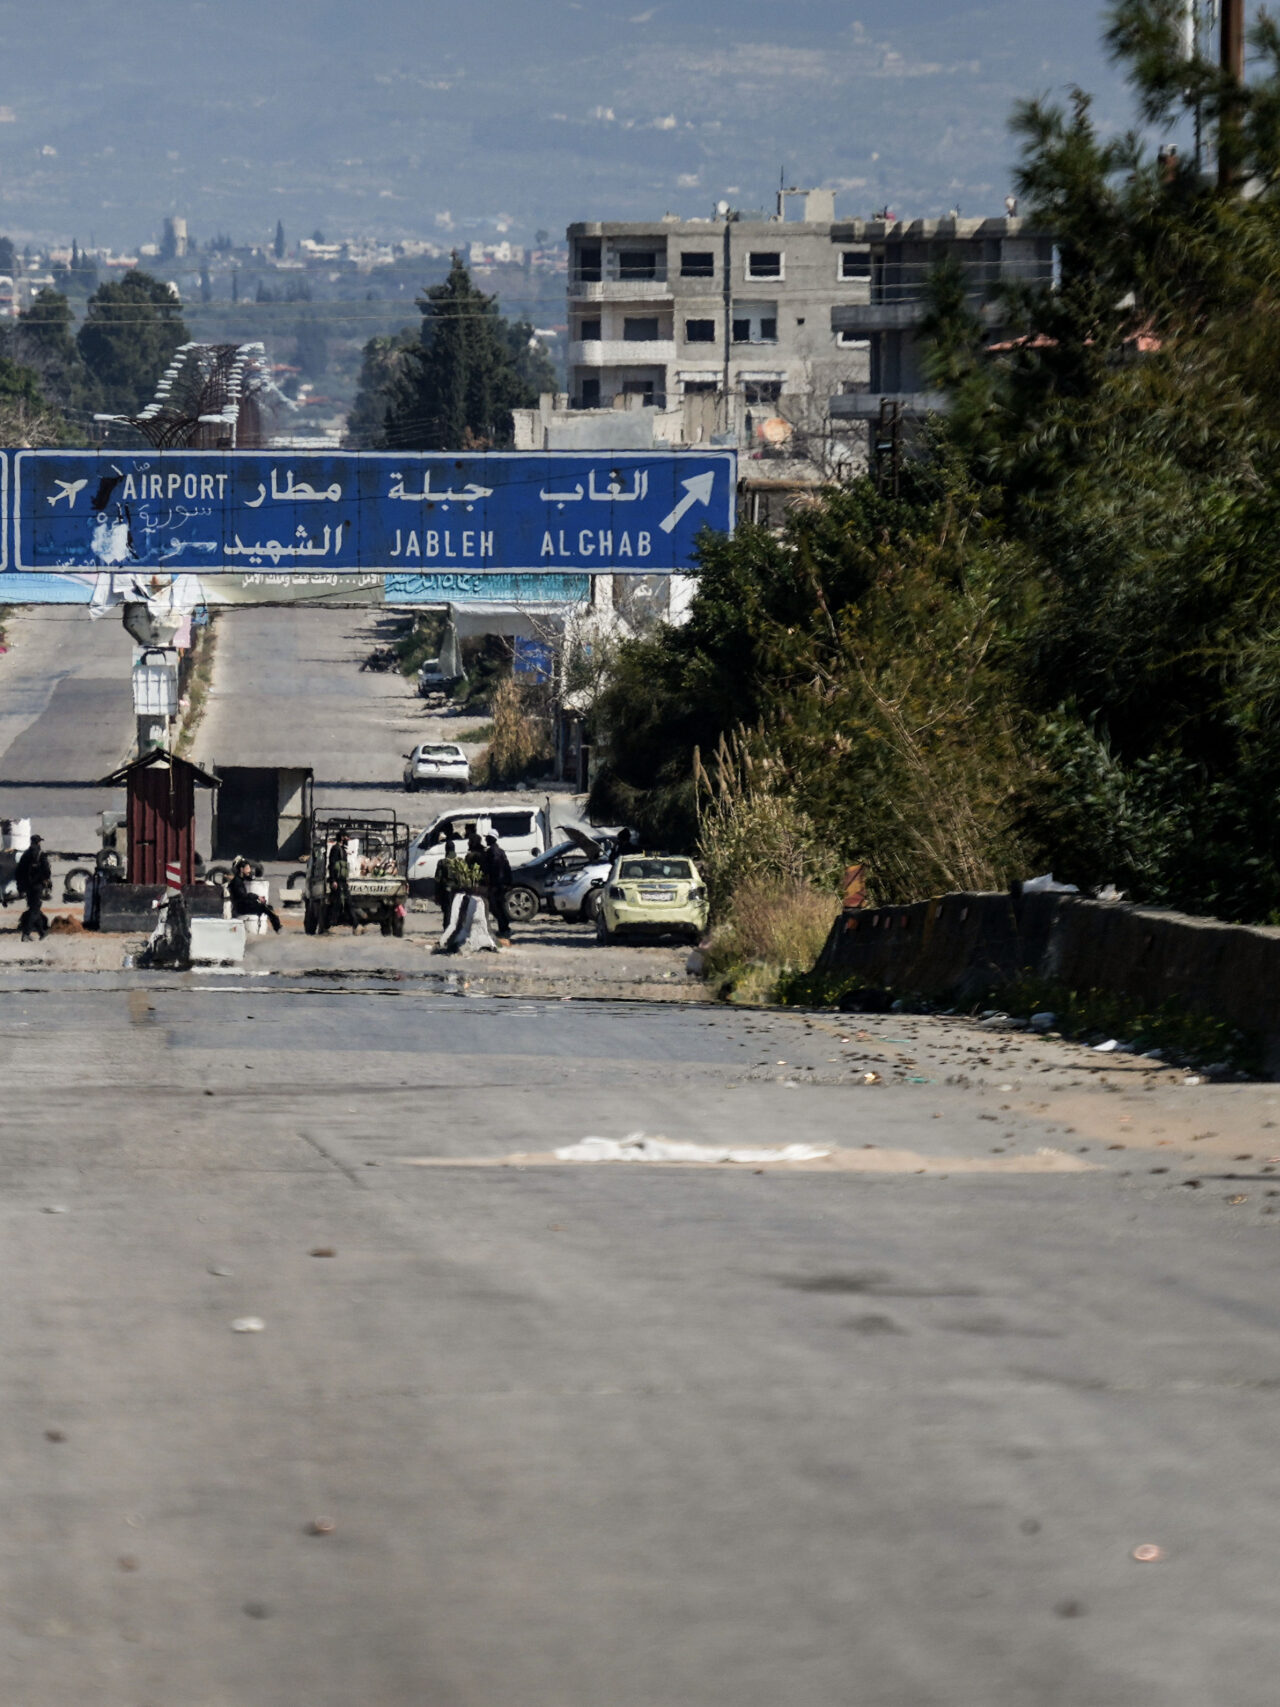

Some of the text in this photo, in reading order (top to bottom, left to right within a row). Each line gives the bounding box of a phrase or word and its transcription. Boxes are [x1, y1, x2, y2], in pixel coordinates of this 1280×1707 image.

[122, 473, 228, 500] AIRPORT
[243, 468, 342, 508] مطار
[387, 470, 494, 512] جبلة
[539, 469, 648, 509] الغاب
[223, 524, 343, 565] الشهيد
[389, 529, 494, 557] JABLEH
[349, 885, 389, 893] HANGHE
